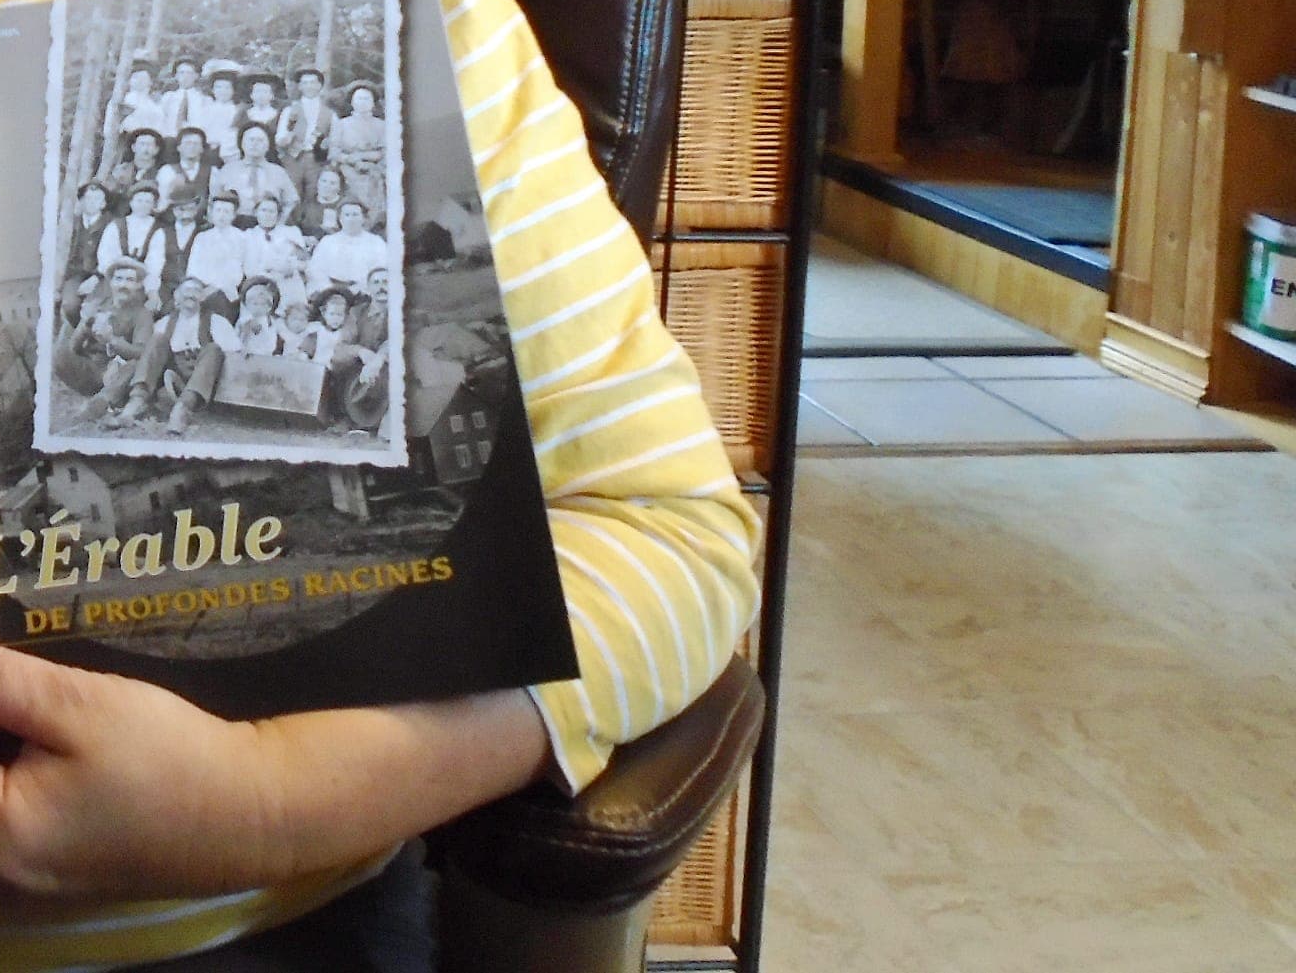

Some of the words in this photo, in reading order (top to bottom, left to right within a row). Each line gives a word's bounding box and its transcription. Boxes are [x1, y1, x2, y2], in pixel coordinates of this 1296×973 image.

[25, 607, 71, 634] DE
[84, 578, 293, 625] PROFONDES
[305, 555, 455, 598] RACINES
